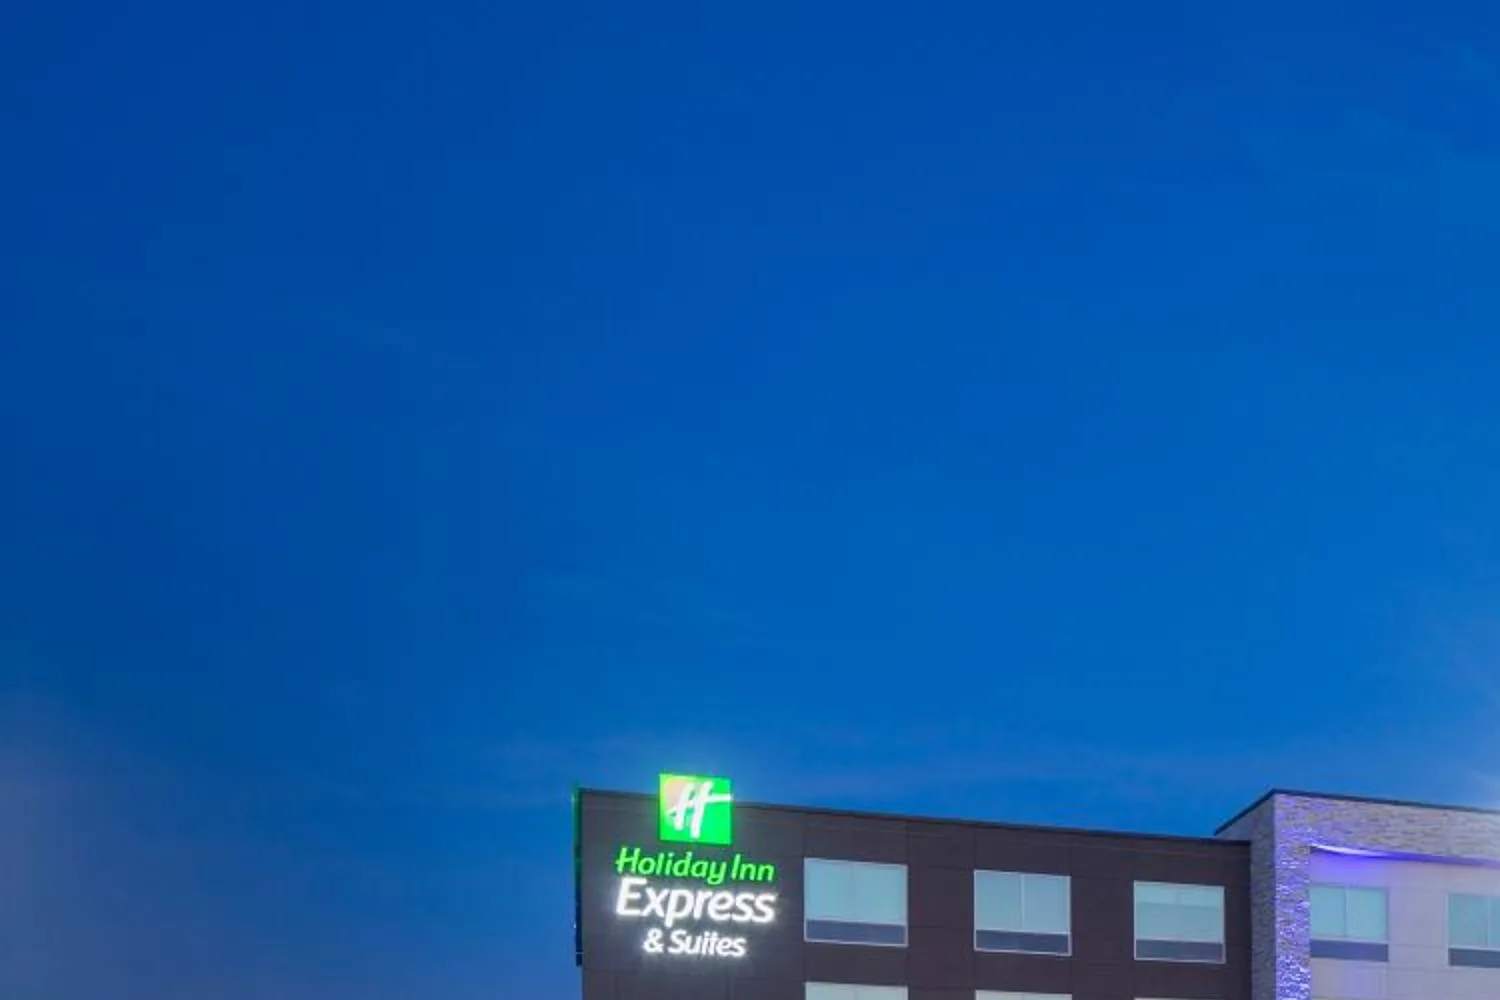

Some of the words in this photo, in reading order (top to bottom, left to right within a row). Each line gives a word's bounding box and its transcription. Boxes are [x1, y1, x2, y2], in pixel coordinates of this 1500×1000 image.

[615, 847, 726, 885] Holiday
[731, 853, 776, 882] Inn
[615, 876, 777, 928] Express
[643, 928, 664, 953] &
[667, 929, 747, 957] Suites
